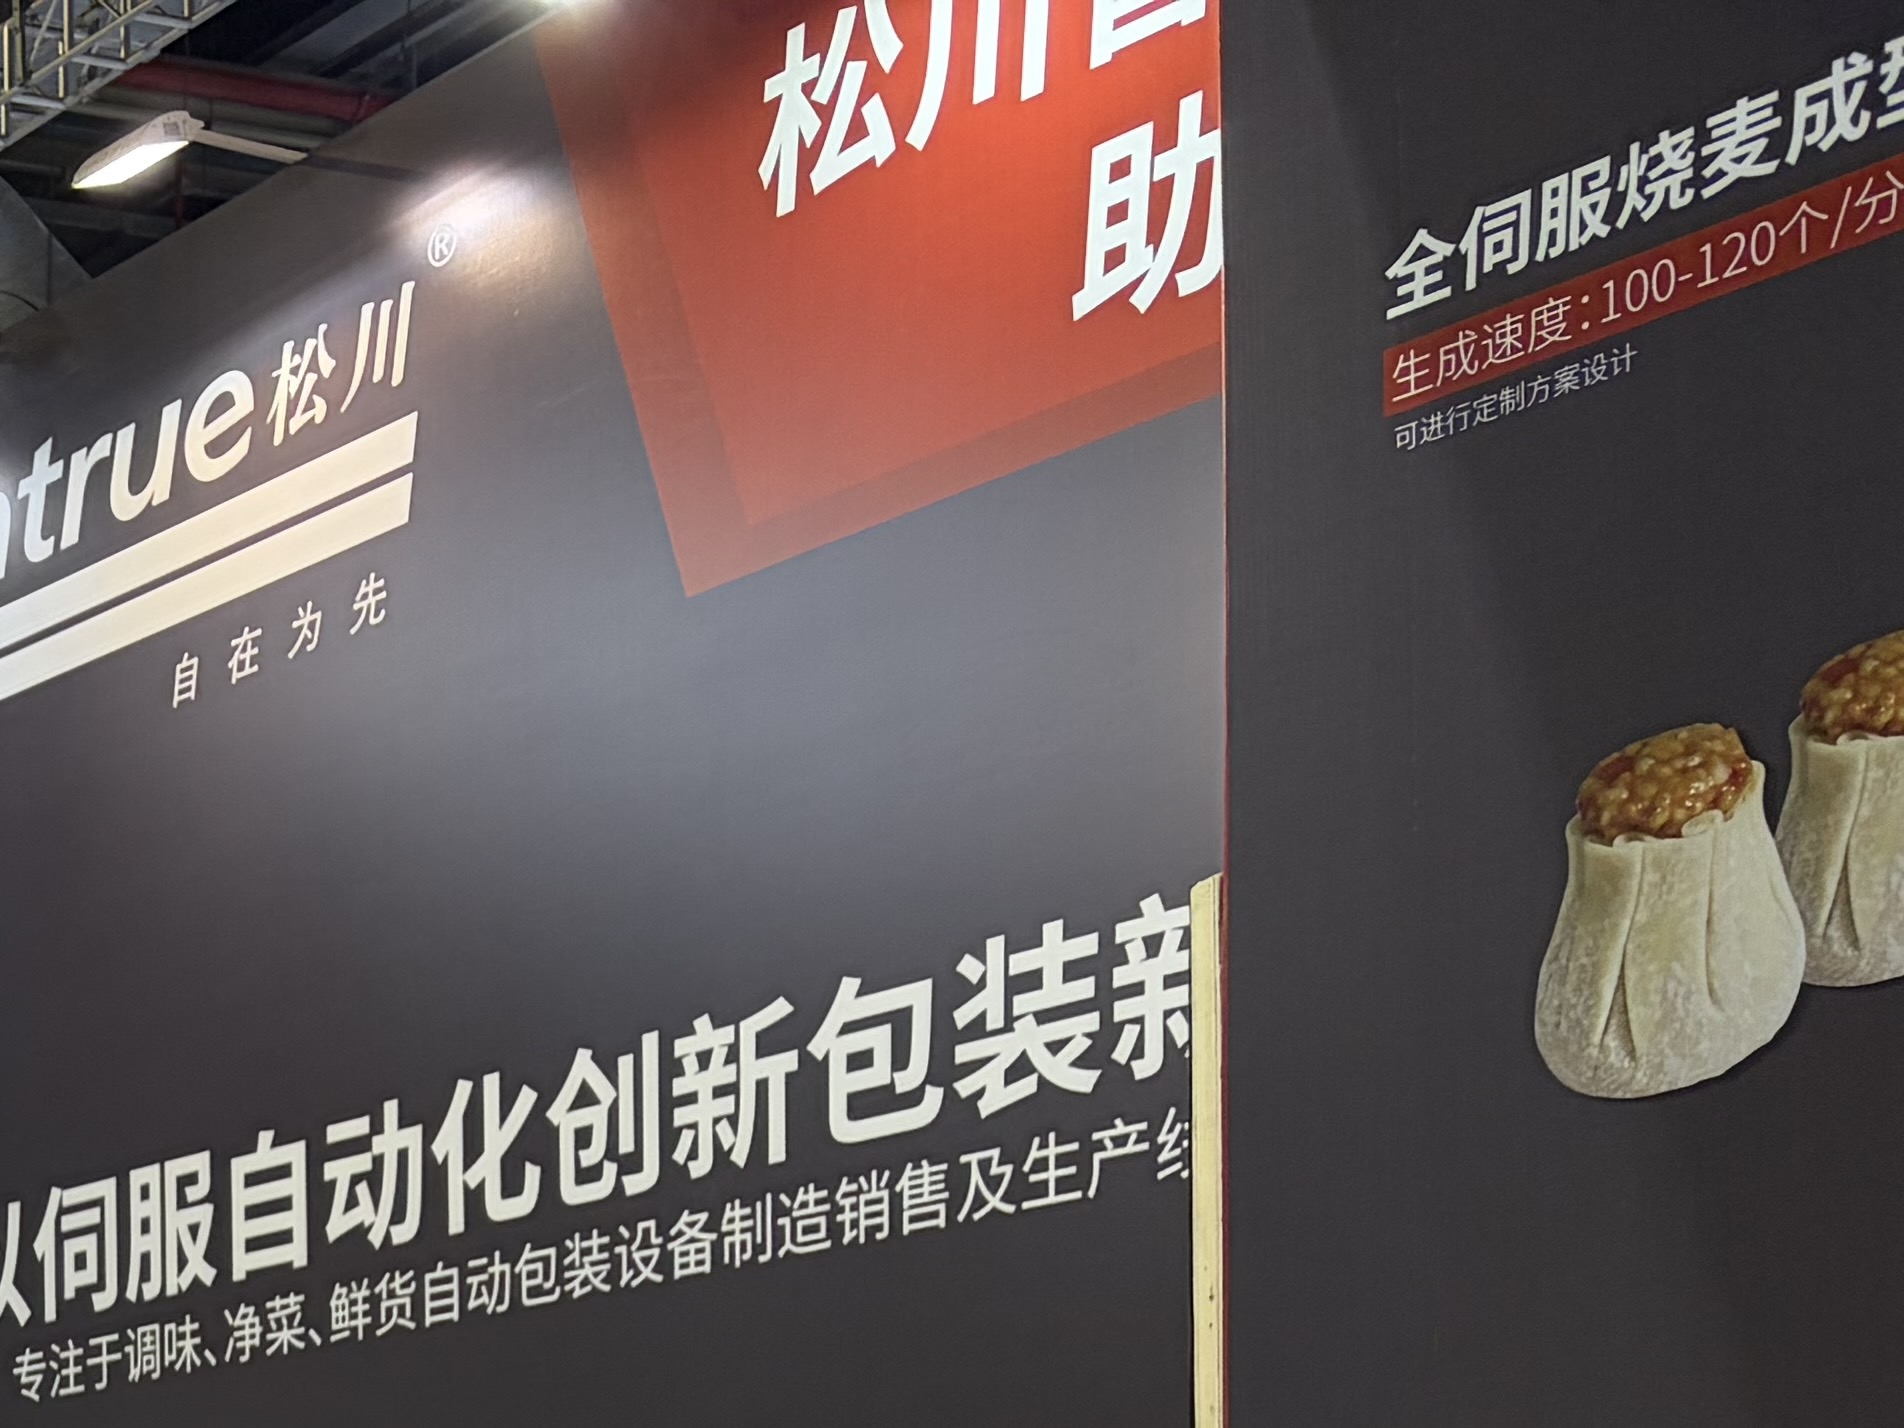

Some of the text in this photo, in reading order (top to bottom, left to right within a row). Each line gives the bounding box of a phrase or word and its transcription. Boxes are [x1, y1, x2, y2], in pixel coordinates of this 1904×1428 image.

[265, 281, 416, 446] 松川
[1394, 342, 1639, 452] 可进行定制方案设计
[171, 572, 389, 709] 自在为先
